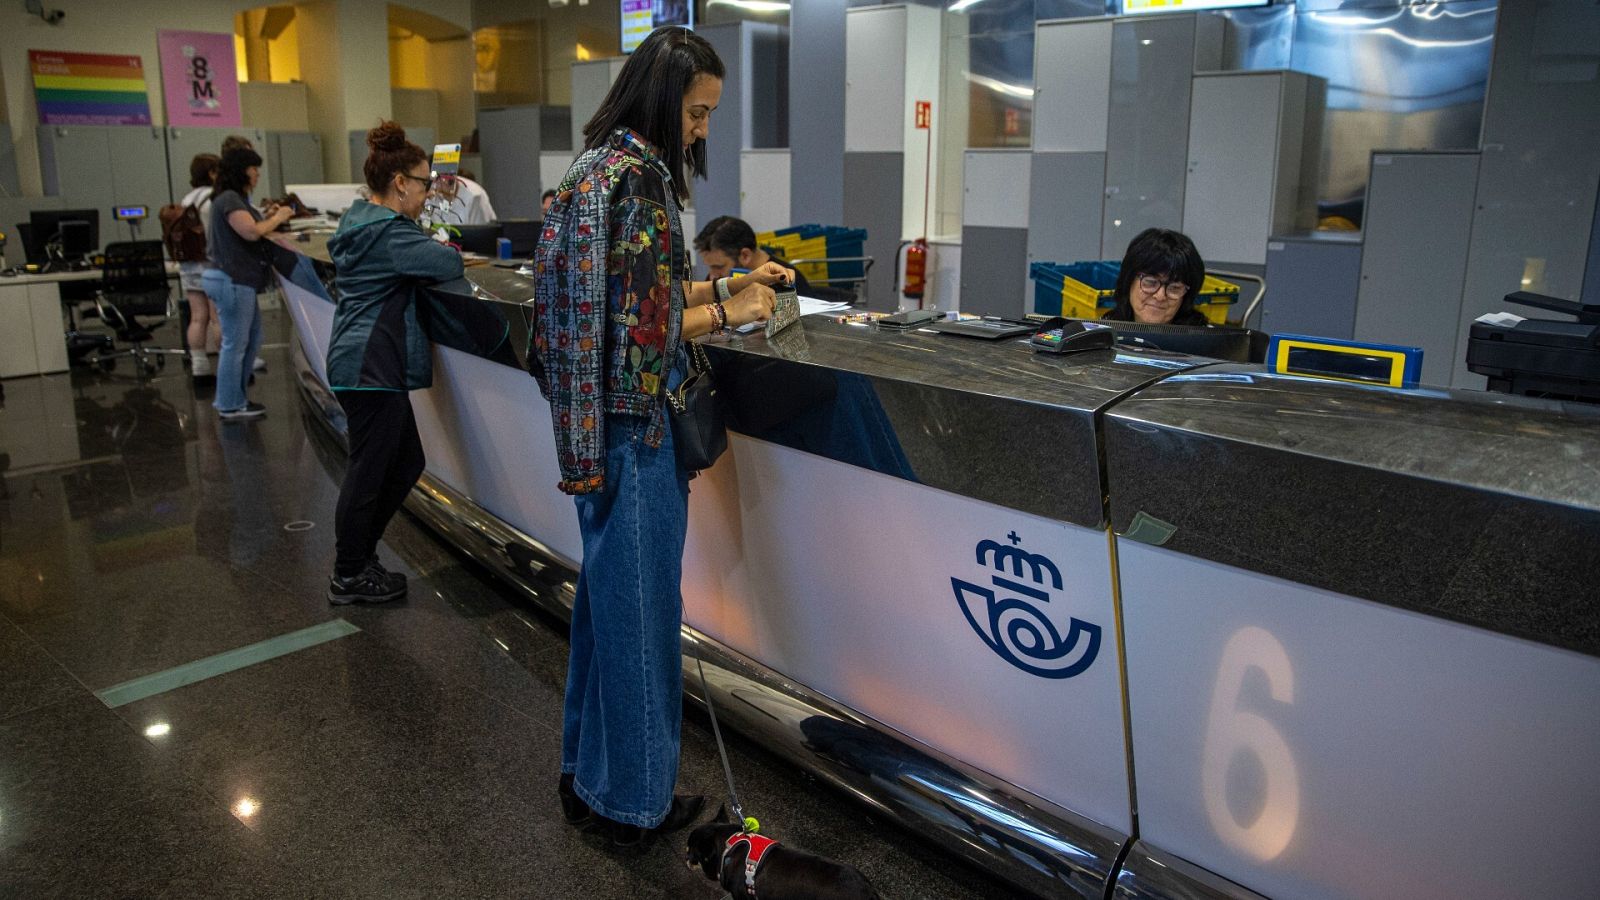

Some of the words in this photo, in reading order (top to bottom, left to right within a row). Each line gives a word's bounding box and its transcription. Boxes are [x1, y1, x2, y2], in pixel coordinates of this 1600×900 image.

[193, 57, 207, 79] 8
[194, 80, 214, 99] M
[1204, 626, 1299, 861] 6
